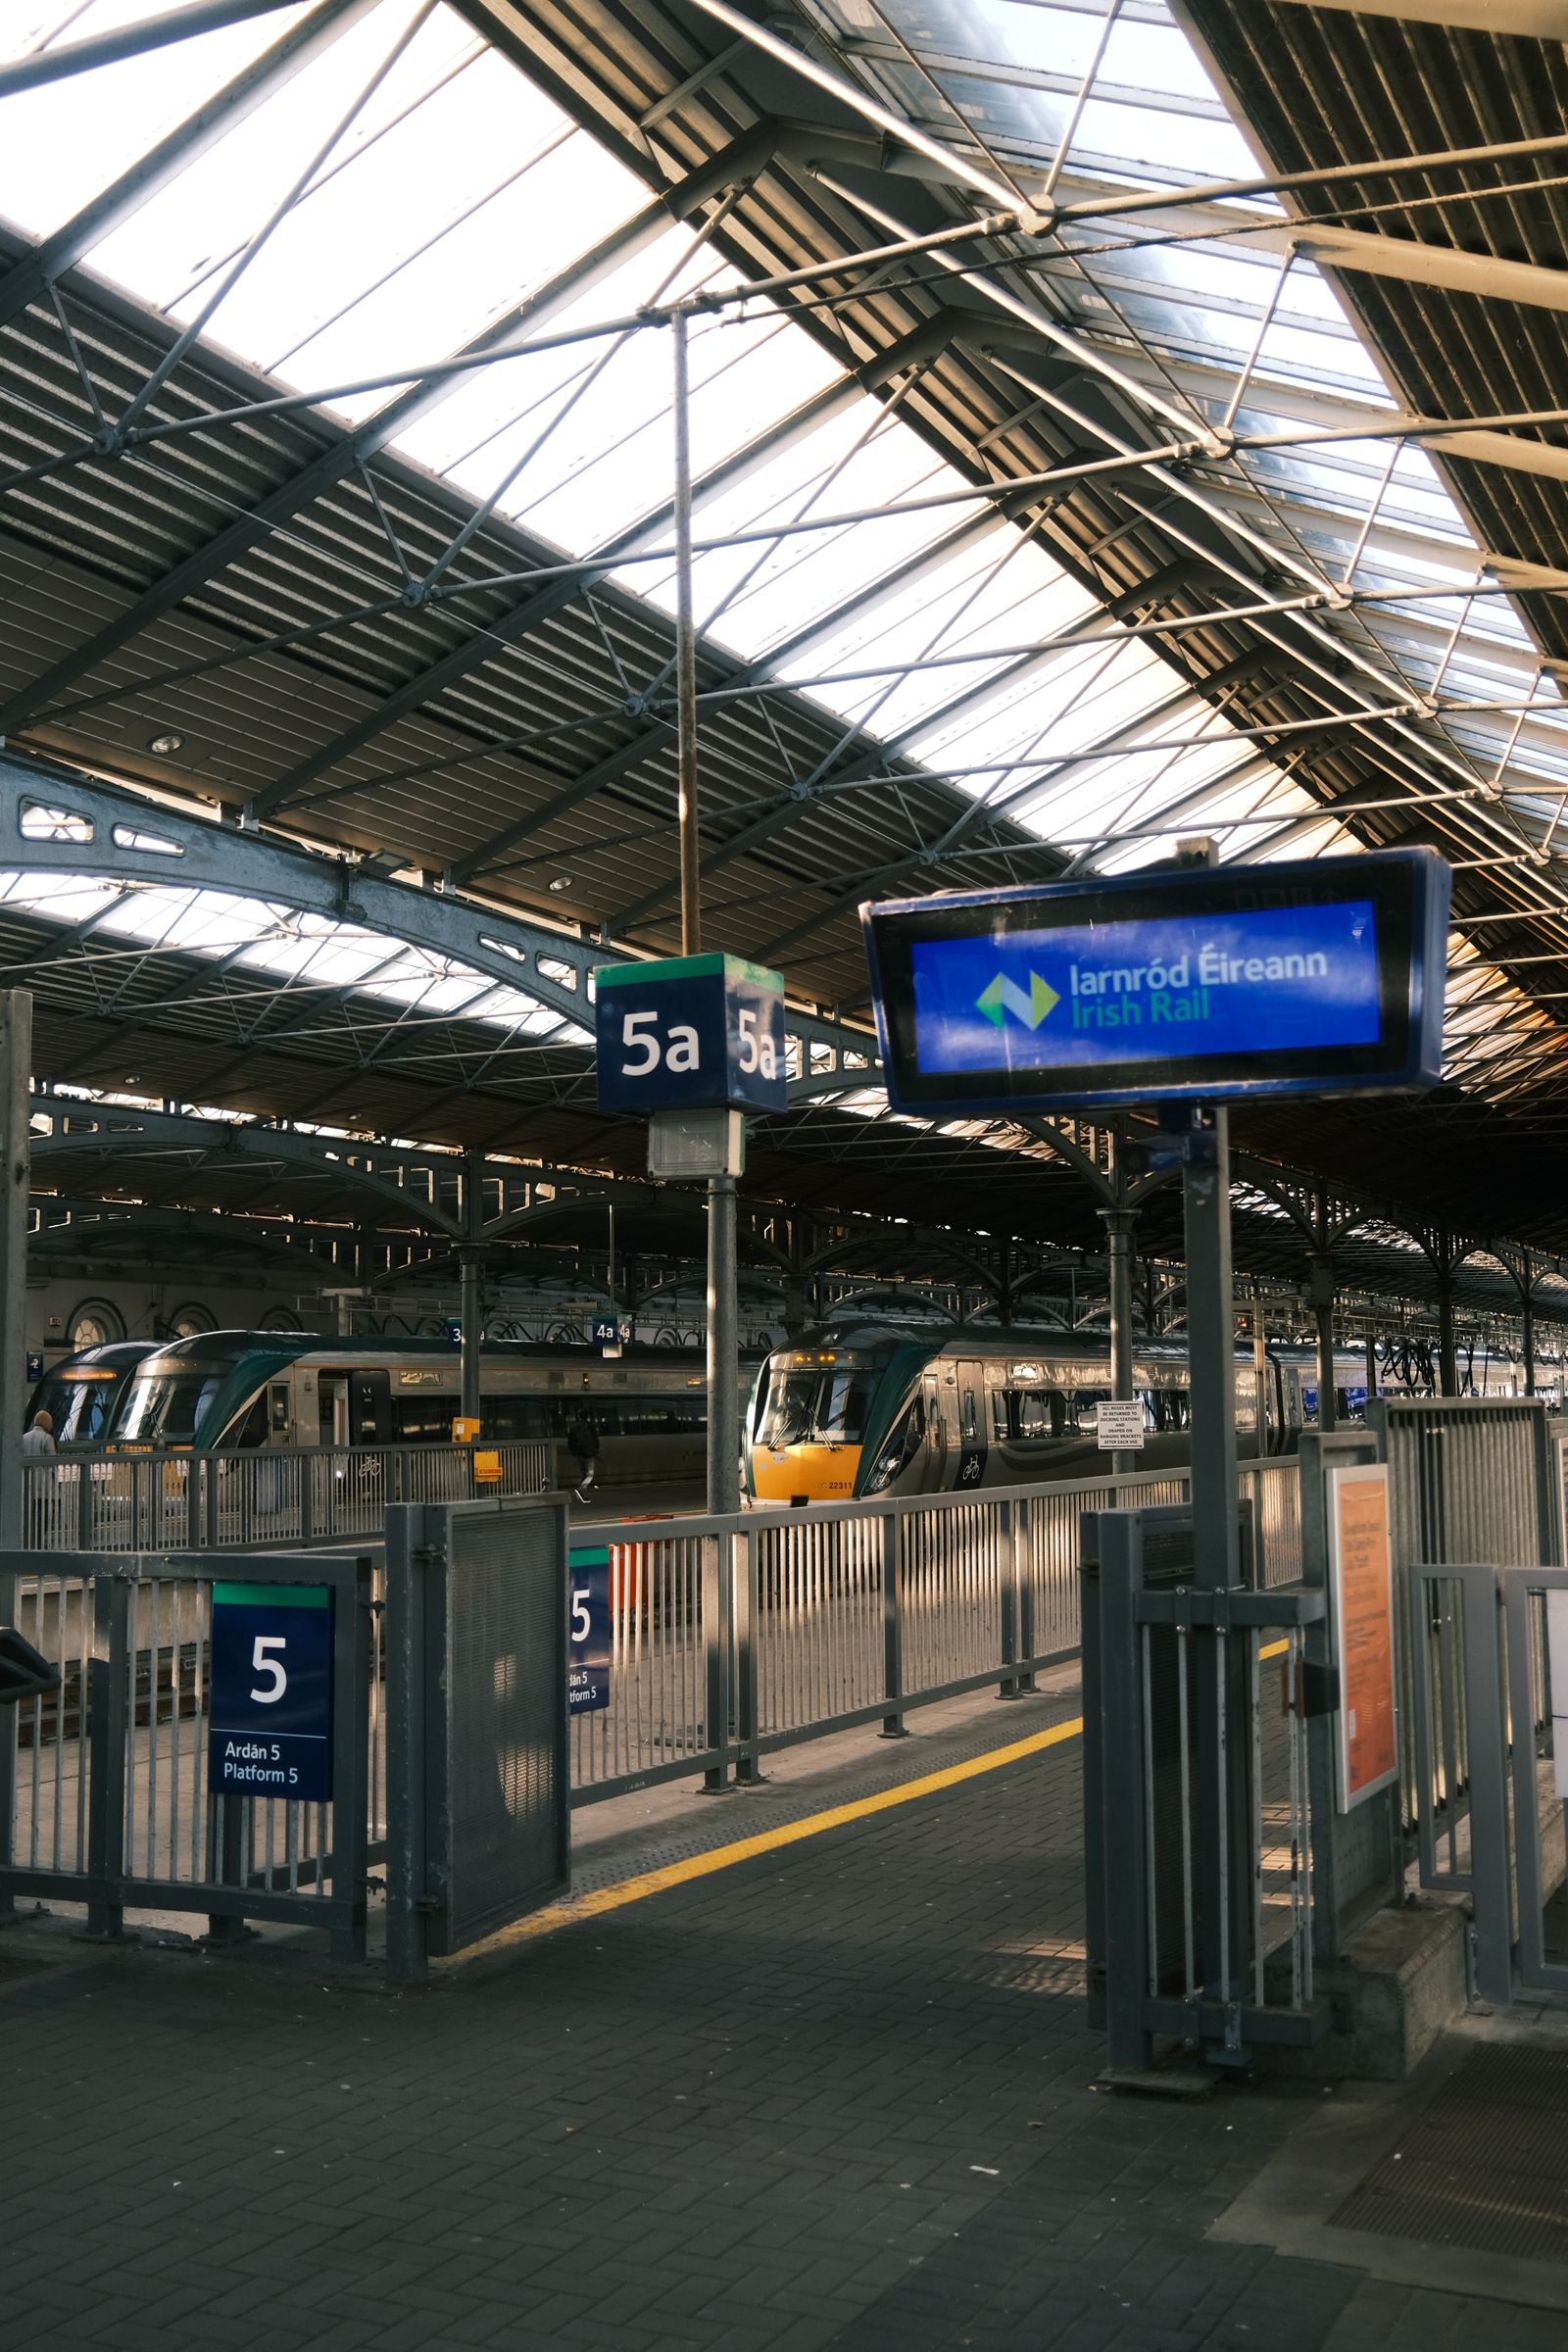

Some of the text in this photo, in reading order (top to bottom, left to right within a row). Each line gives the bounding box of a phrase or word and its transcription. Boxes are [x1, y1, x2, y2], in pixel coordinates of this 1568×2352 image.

[1070, 943, 1327, 996] Iarnród Éireann
[1072, 988, 1210, 1029] Irish Rail
[621, 1010, 700, 1076] 5a
[738, 1008, 776, 1080] 5a
[596, 1324, 613, 1339] 4a
[619, 1324, 630, 1339] 4a
[571, 1589, 591, 1642] 5
[250, 1636, 287, 1704] 5
[582, 1670, 588, 1685] 5
[591, 1686, 597, 1699] 5
[224, 1740, 280, 1761] Ardán 5
[223, 1762, 299, 1785] Platform 5
